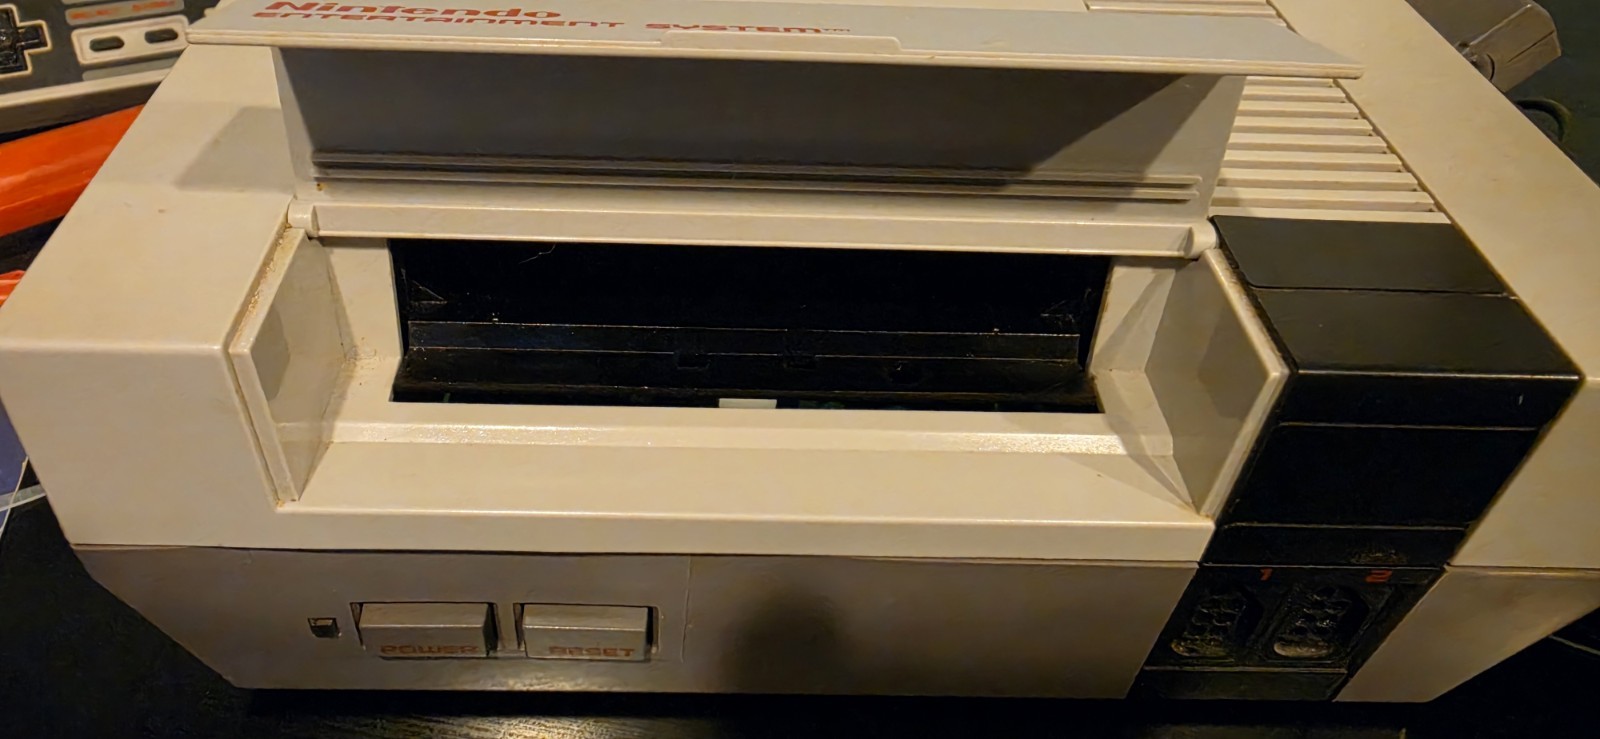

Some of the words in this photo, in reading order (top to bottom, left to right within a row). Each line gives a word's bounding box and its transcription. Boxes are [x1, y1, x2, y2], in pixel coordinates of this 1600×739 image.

[264, 1, 562, 19] Nintendo
[253, 12, 625, 28] ENTERTAINMENT
[1260, 568, 1273, 581] 1
[1365, 569, 1393, 584] 2
[380, 644, 479, 656] POWER
[548, 646, 636, 657] RESET
